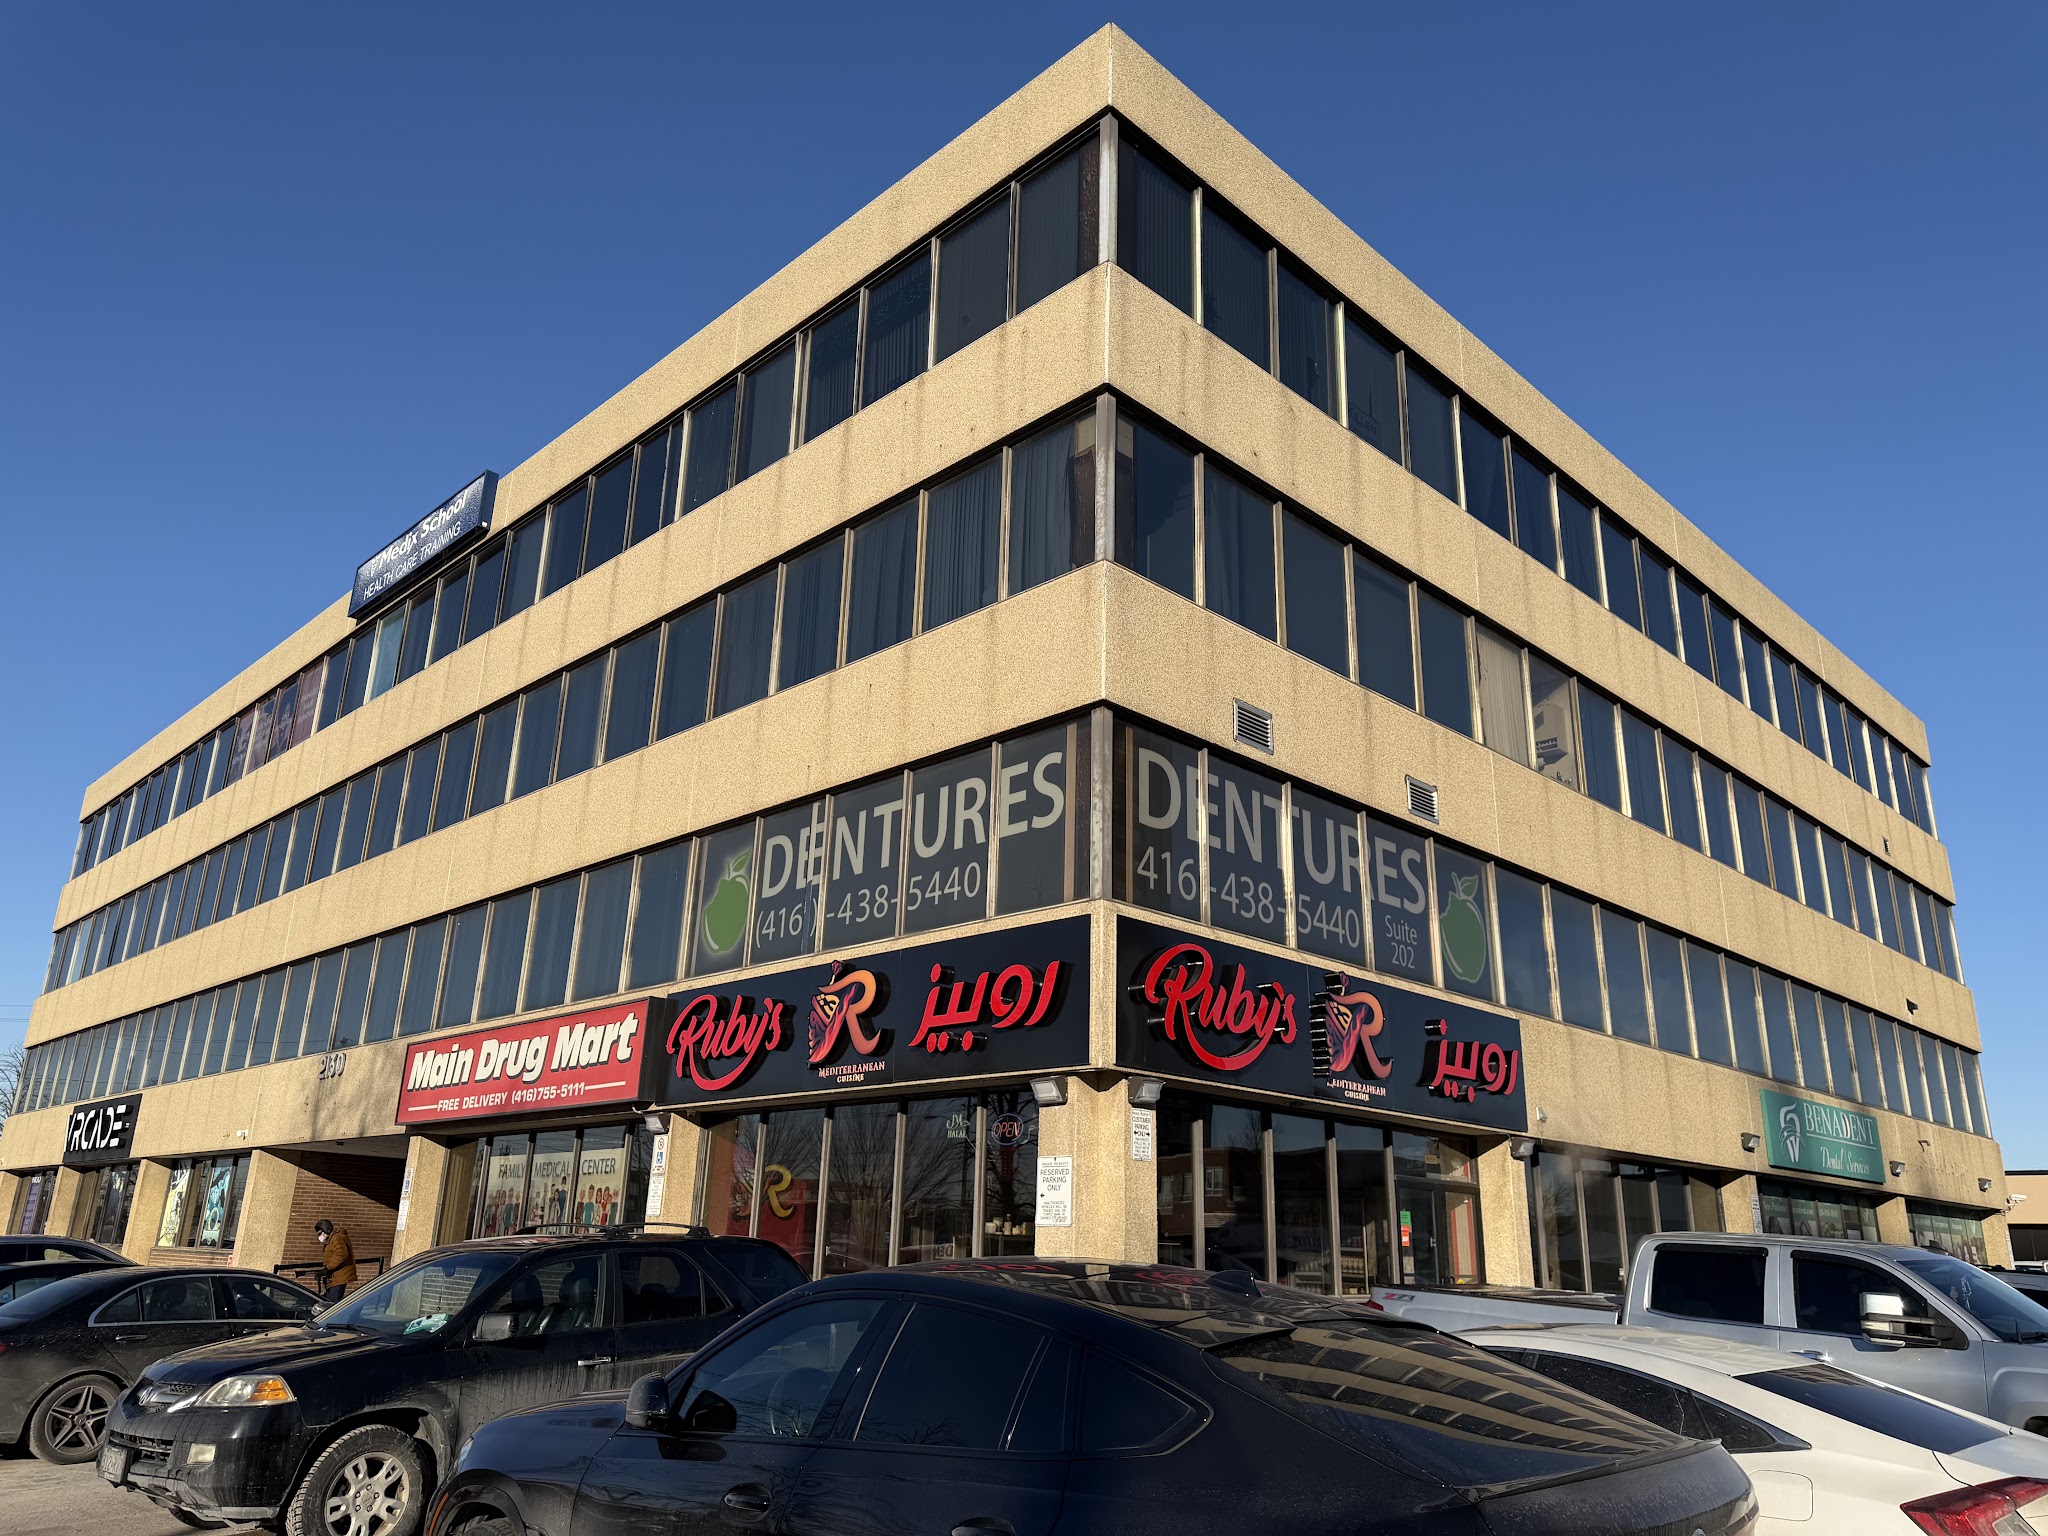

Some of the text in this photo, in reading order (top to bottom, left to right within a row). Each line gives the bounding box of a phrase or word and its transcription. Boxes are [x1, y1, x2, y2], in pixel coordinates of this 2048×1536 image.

[379, 489, 468, 569] Medix School
[363, 521, 461, 601] HEALTH CARE TRAINING
[761, 751, 1065, 899] DENTURES
[1138, 747, 1426, 915] DENTURES
[1384, 914, 1418, 945] Suite
[1390, 941, 1416, 969] 202
[907, 960, 1061, 1053] روبيز
[1144, 943, 1297, 1071] Ruby's
[407, 1012, 640, 1090] Main Drug Mart
[666, 994, 784, 1091] Ruby's
[818, 1060, 886, 1079] MEDITERRANEAN
[1430, 1018, 1519, 1104] روبيز
[836, 1073, 865, 1083] CUISINE
[437, 1081, 586, 1112] FREE DELIVERY (416)755-5111
[993, 1121, 1021, 1138] OPEN
[1803, 1102, 1874, 1145] BENADENT
[498, 1157, 617, 1180] FAMILY MEDICAL CENTER
[1040, 1168, 1070, 1176] RESERVED
[1820, 1146, 1870, 1175] Dental Services
[1042, 1176, 1067, 1184] PARKING
[1046, 1184, 1062, 1192] ONLY
